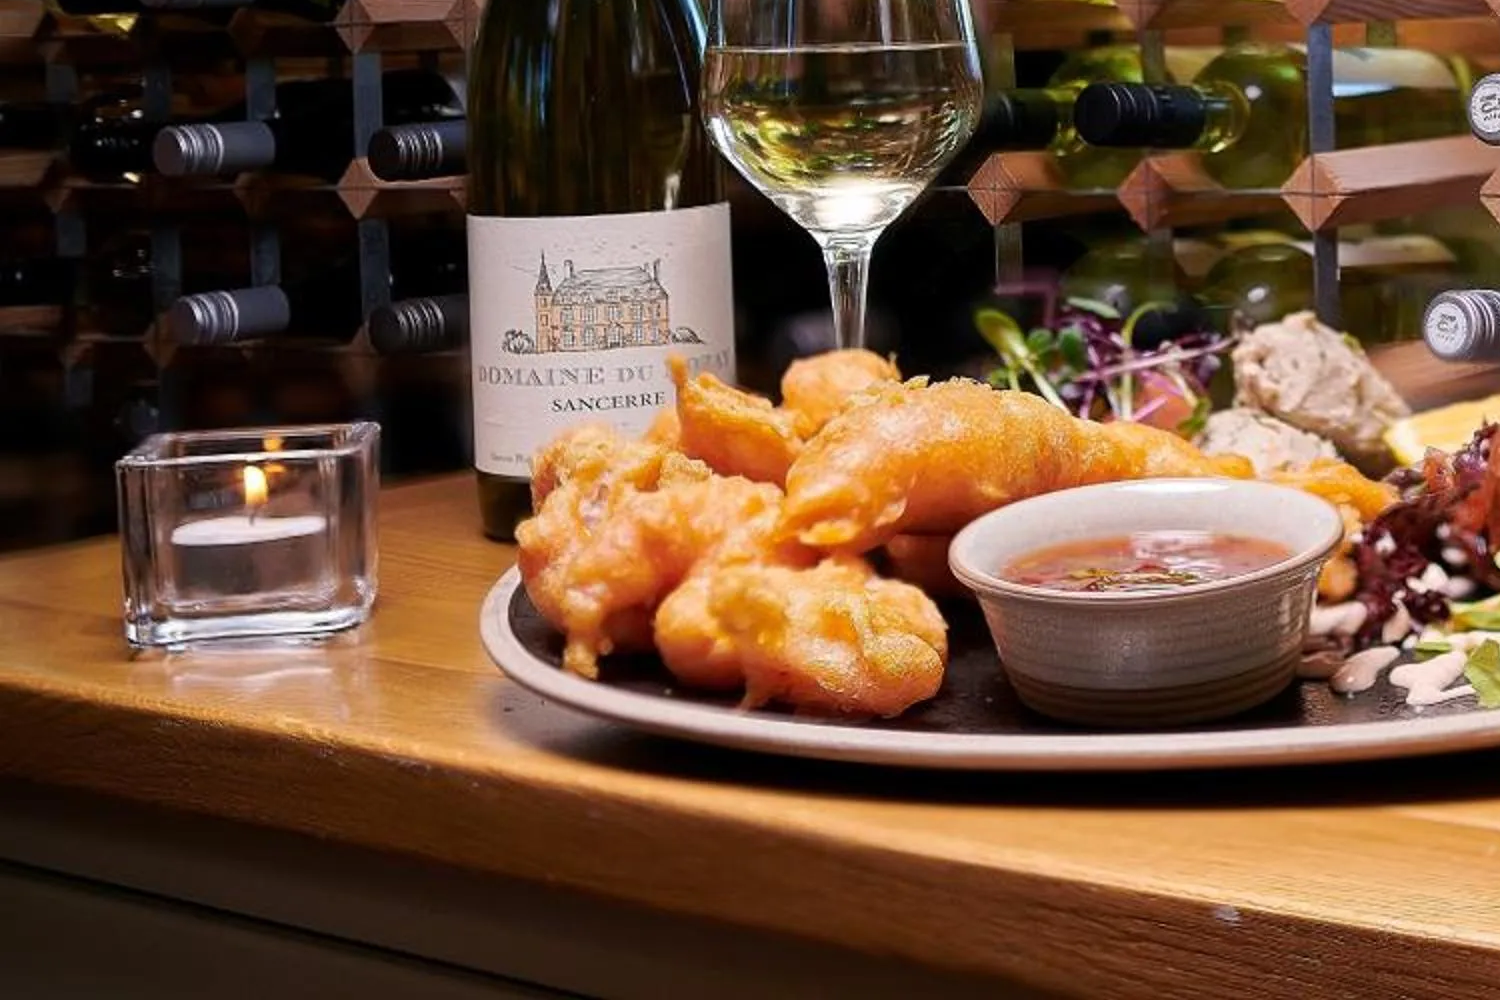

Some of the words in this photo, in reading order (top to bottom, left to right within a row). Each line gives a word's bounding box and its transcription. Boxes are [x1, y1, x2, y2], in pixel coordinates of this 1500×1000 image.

[478, 366, 604, 386] DOMAINE
[617, 365, 654, 382] DU
[551, 391, 665, 412] SANCERRE
